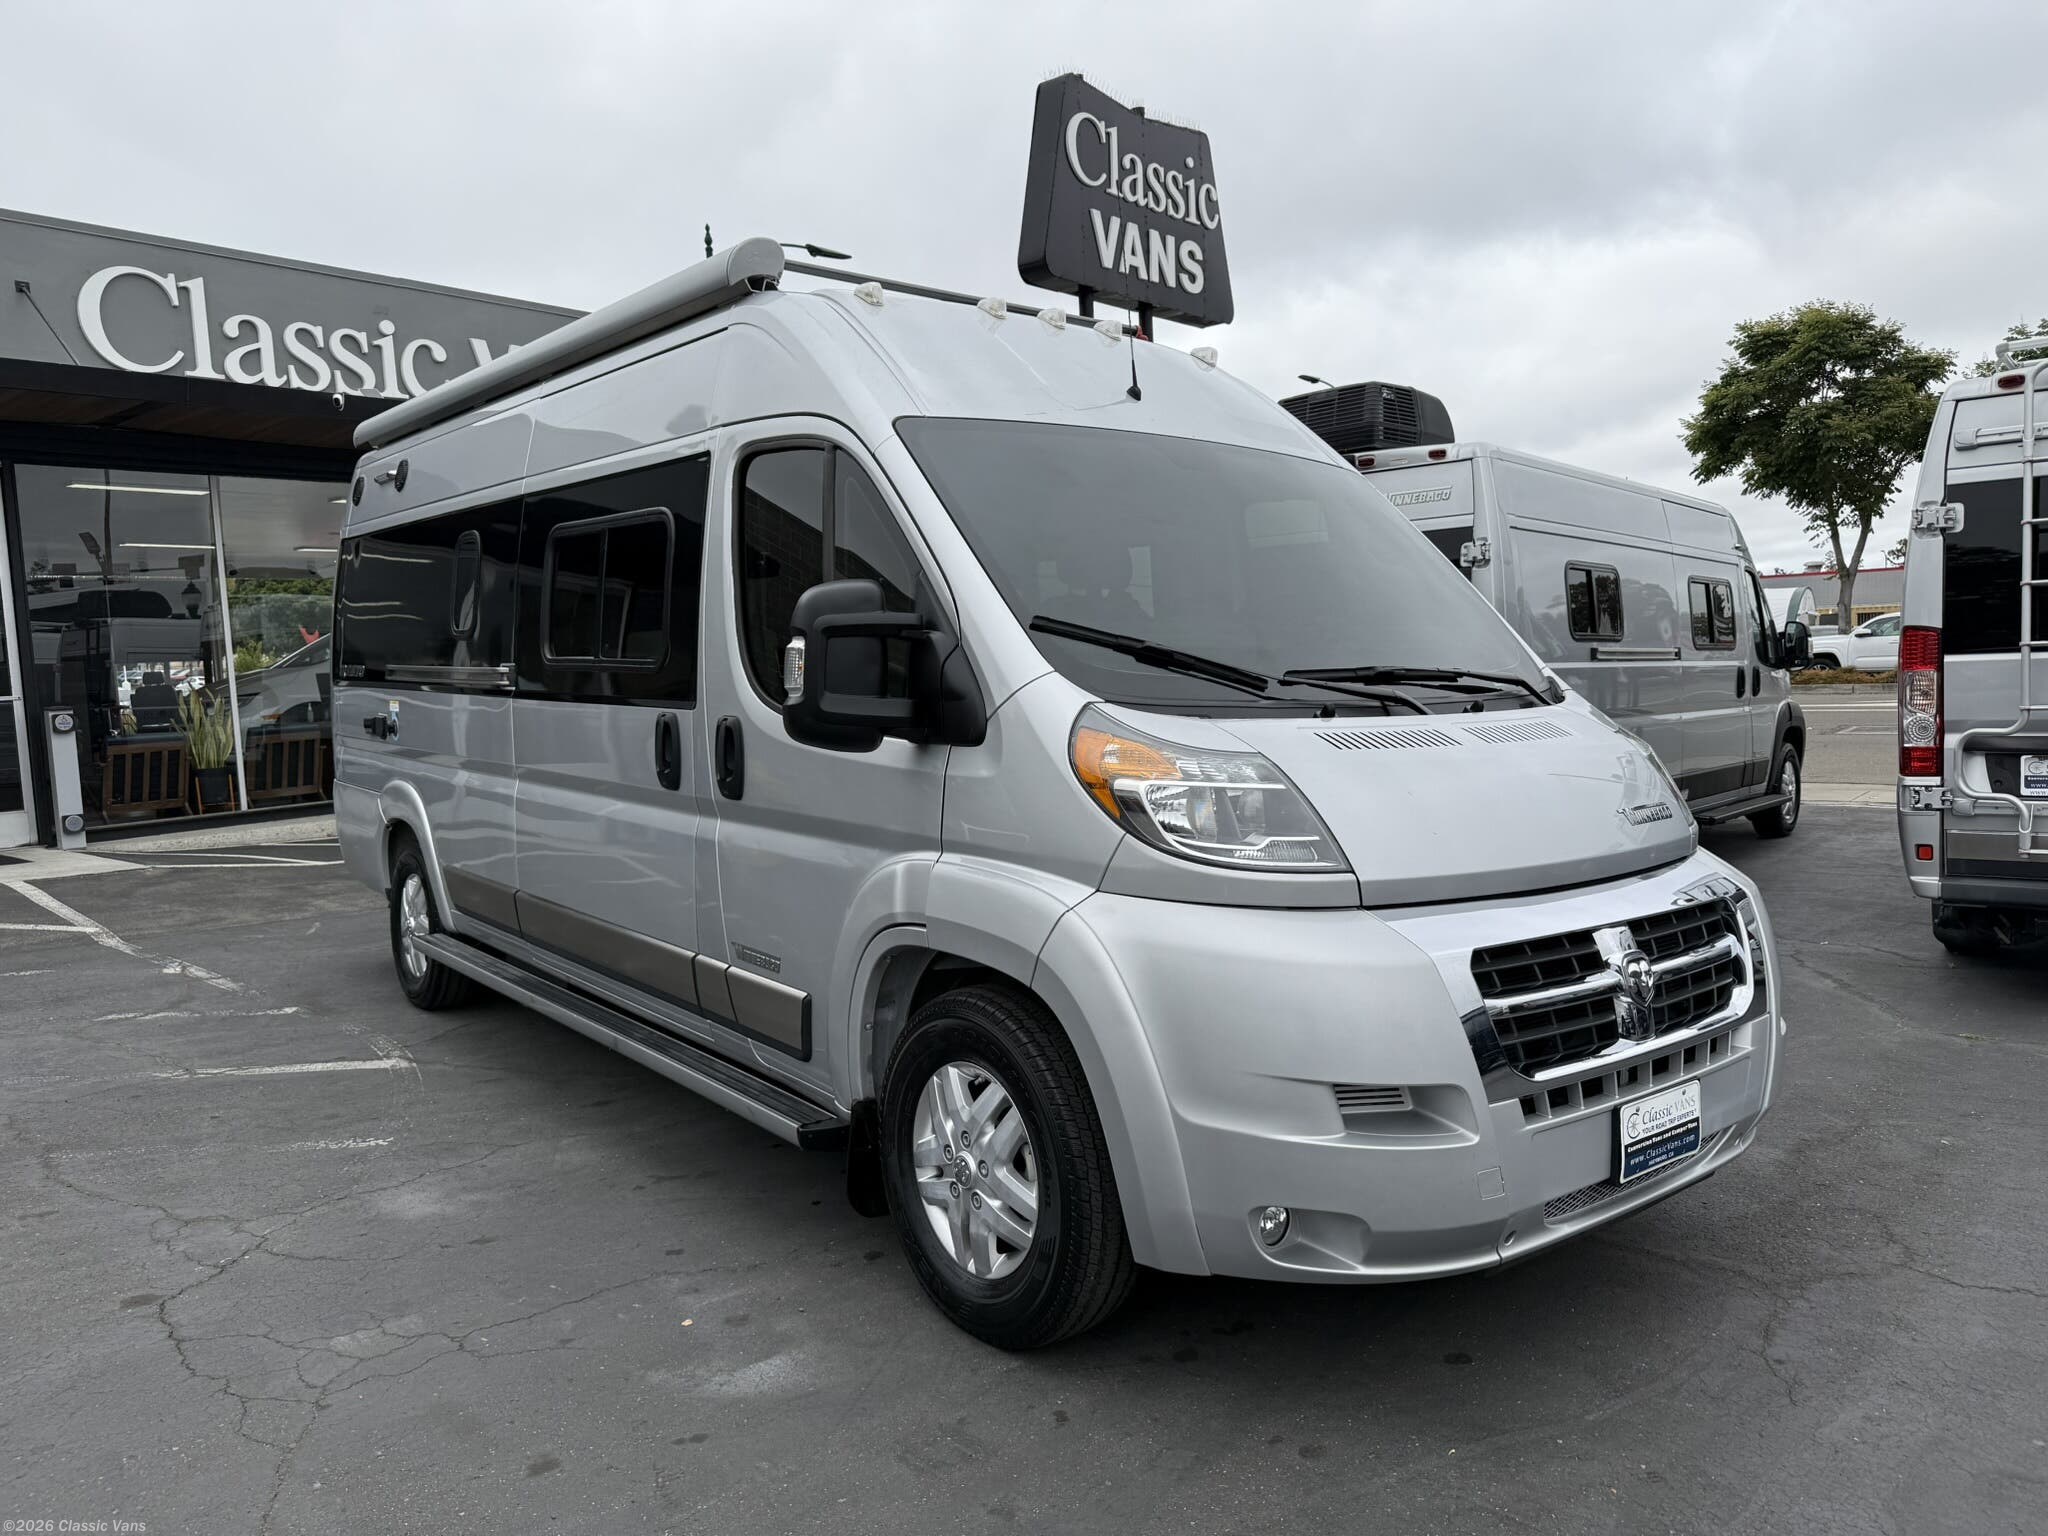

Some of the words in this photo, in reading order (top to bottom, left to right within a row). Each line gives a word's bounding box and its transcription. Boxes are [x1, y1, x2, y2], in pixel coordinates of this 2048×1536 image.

[1065, 111, 1220, 230] Classic
[1089, 208, 1205, 294] VANS
[77, 265, 450, 399] Classic
[1386, 488, 1452, 507] INNEBAGO
[1642, 1104, 1673, 1125] Classic
[1675, 1096, 1696, 1111] VANS
[1630, 1134, 1696, 1166] www.ClassicVans.com
